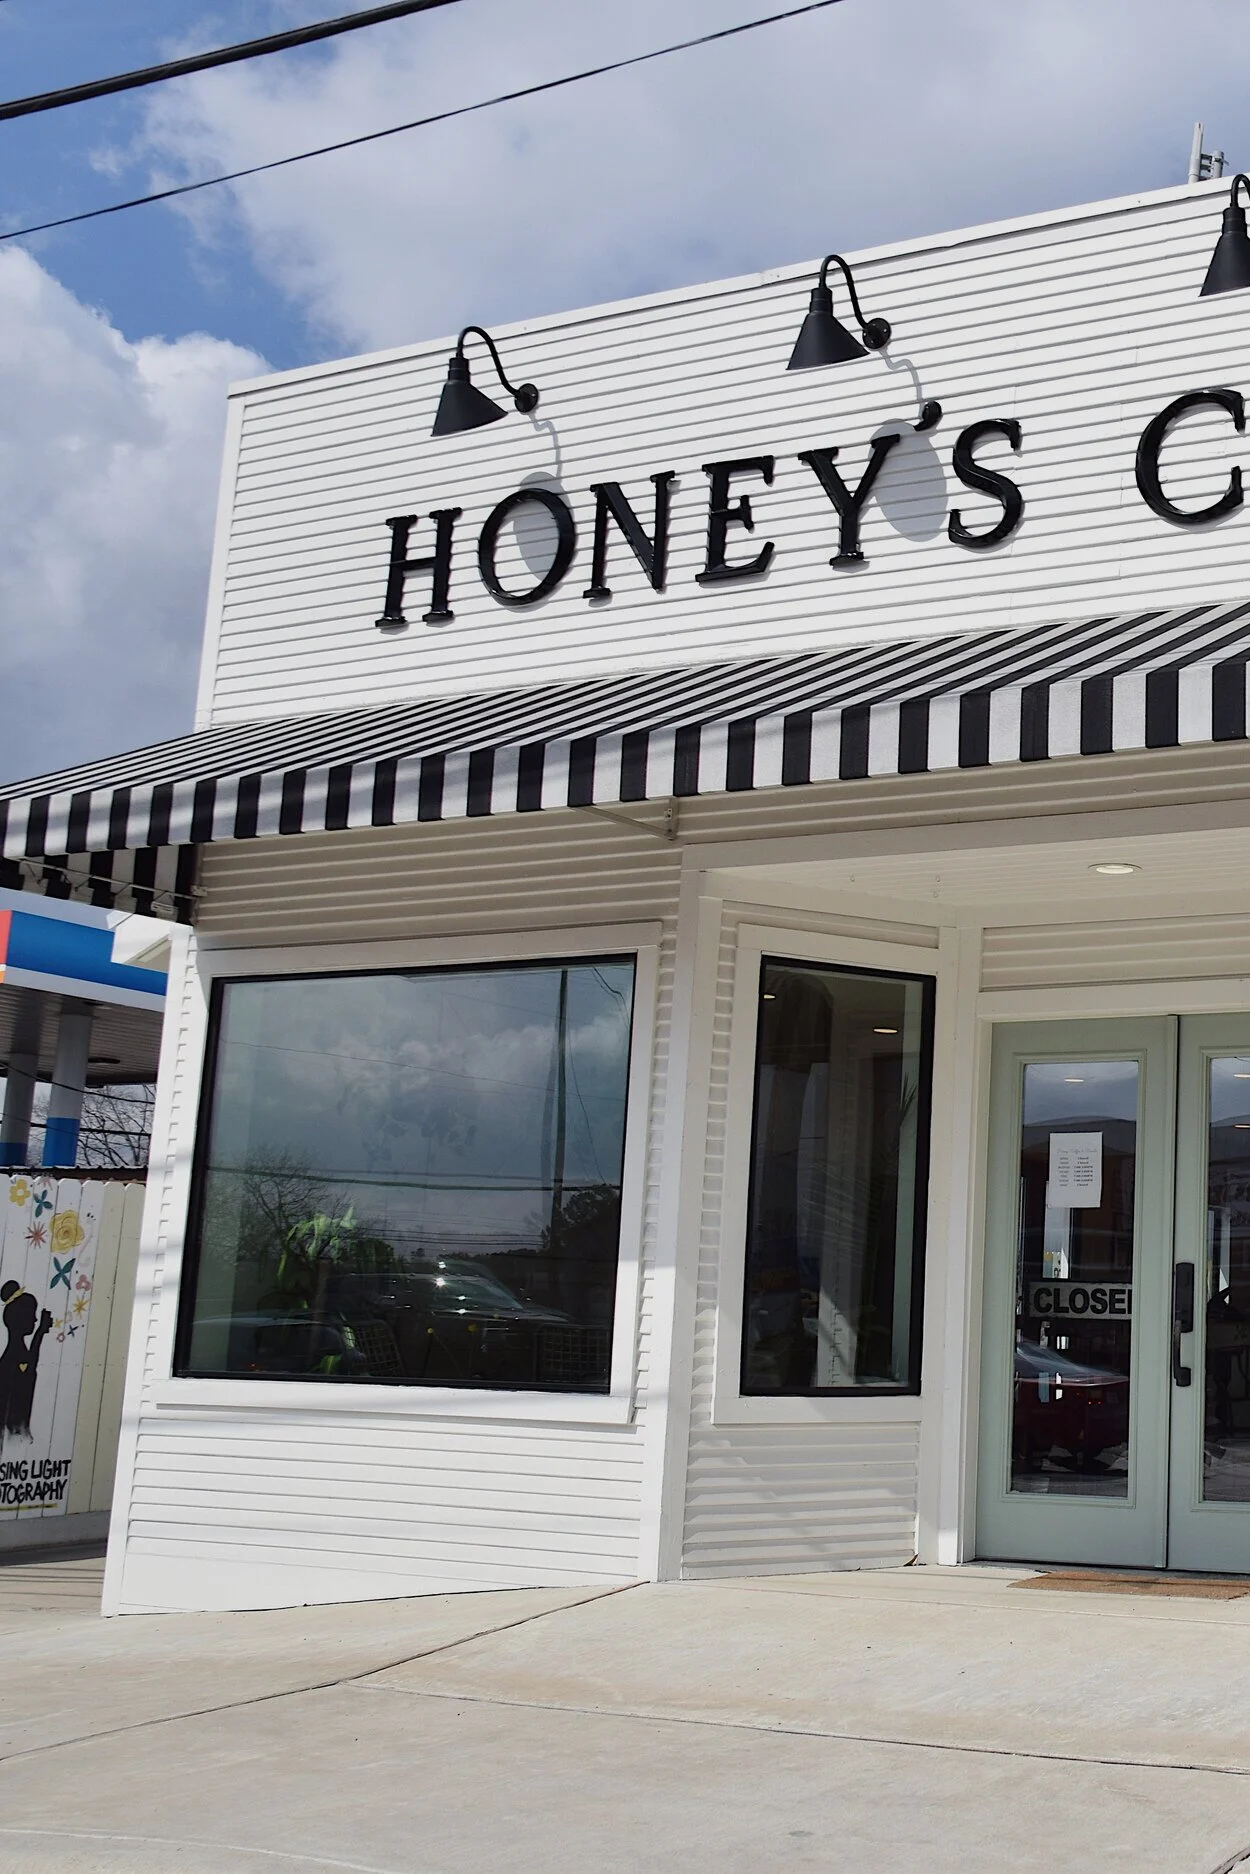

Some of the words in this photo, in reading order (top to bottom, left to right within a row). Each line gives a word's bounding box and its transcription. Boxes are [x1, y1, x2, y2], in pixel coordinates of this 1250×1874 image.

[375, 401, 1024, 628] HONEY'S
[1033, 1287, 1132, 1315] CLOSE
[31, 1458, 72, 1480] LIGHT
[0, 1479, 68, 1504] TOGRAPHY
